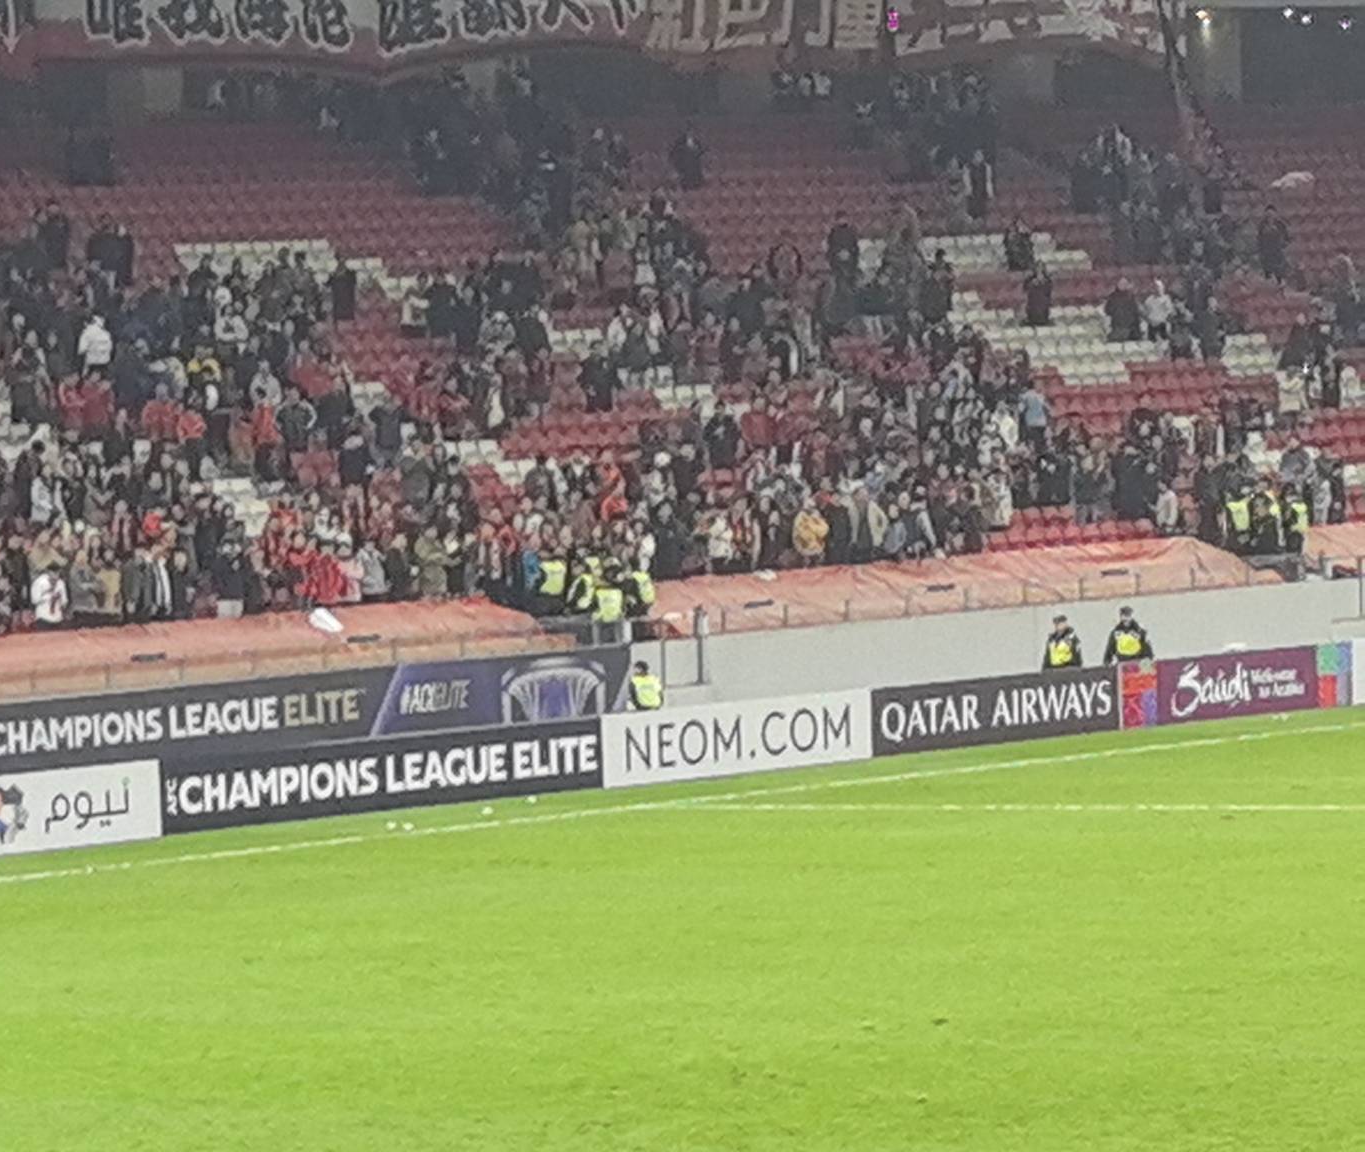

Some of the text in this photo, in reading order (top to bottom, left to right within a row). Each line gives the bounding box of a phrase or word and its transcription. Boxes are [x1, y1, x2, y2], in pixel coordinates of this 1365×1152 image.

[169, 696, 280, 741] LEAGUE
[283, 688, 360, 727] ELITE
[624, 703, 853, 773] NEOM.COM
[880, 679, 1112, 743] QATAR AIRWAYS
[43, 776, 131, 834] نيوم
[178, 757, 379, 815] CHAMPIONS
[385, 745, 508, 794] LEAGUE
[513, 735, 598, 781] ELITE
